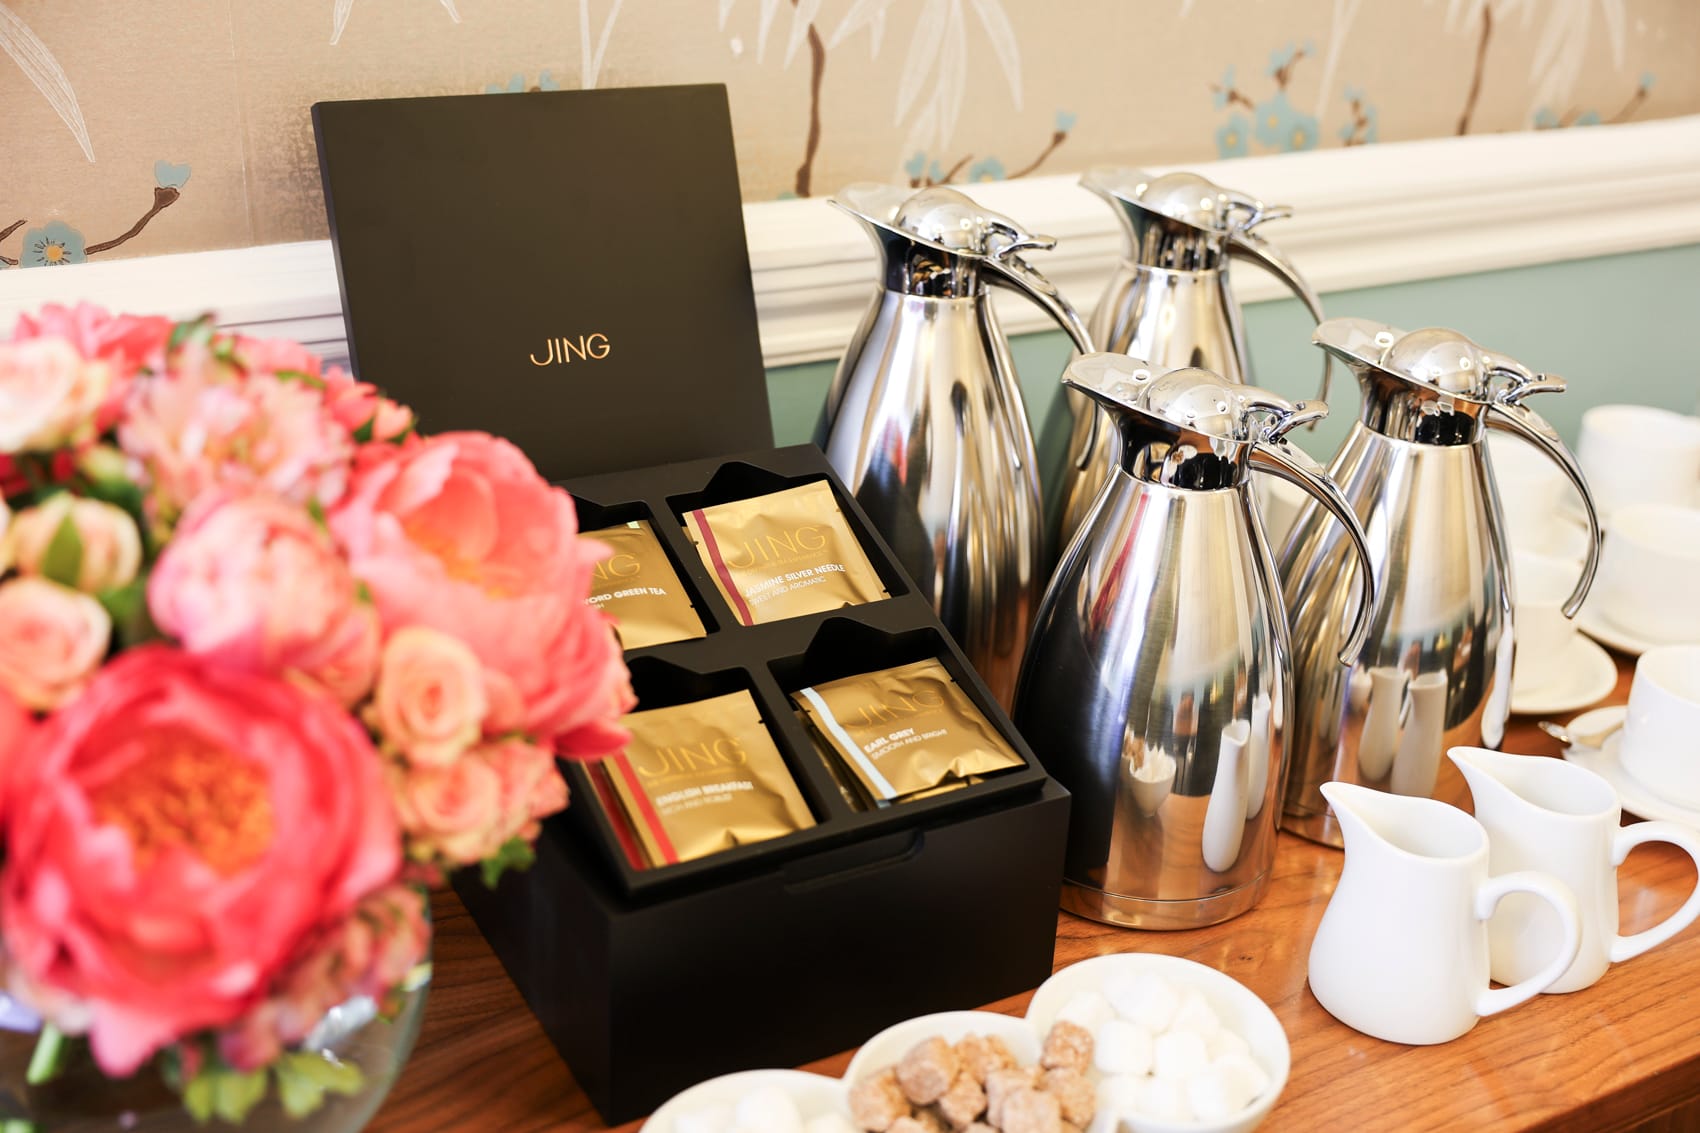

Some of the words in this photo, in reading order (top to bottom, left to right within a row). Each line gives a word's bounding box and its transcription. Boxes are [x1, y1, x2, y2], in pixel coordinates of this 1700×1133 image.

[530, 333, 610, 366] JING
[727, 526, 826, 568] JING
[591, 554, 641, 580] NG
[746, 575, 784, 597] JASMINE
[785, 569, 814, 582] SILVER
[814, 563, 846, 575] NEEDLE
[613, 587, 648, 599] GREEN
[648, 587, 667, 596] TEA
[845, 690, 944, 727] JING
[864, 737, 889, 753] EARL
[889, 727, 914, 741] GREY
[905, 735, 922, 745] AND
[638, 738, 746, 778] JING
[655, 786, 702, 808] ENGLISH
